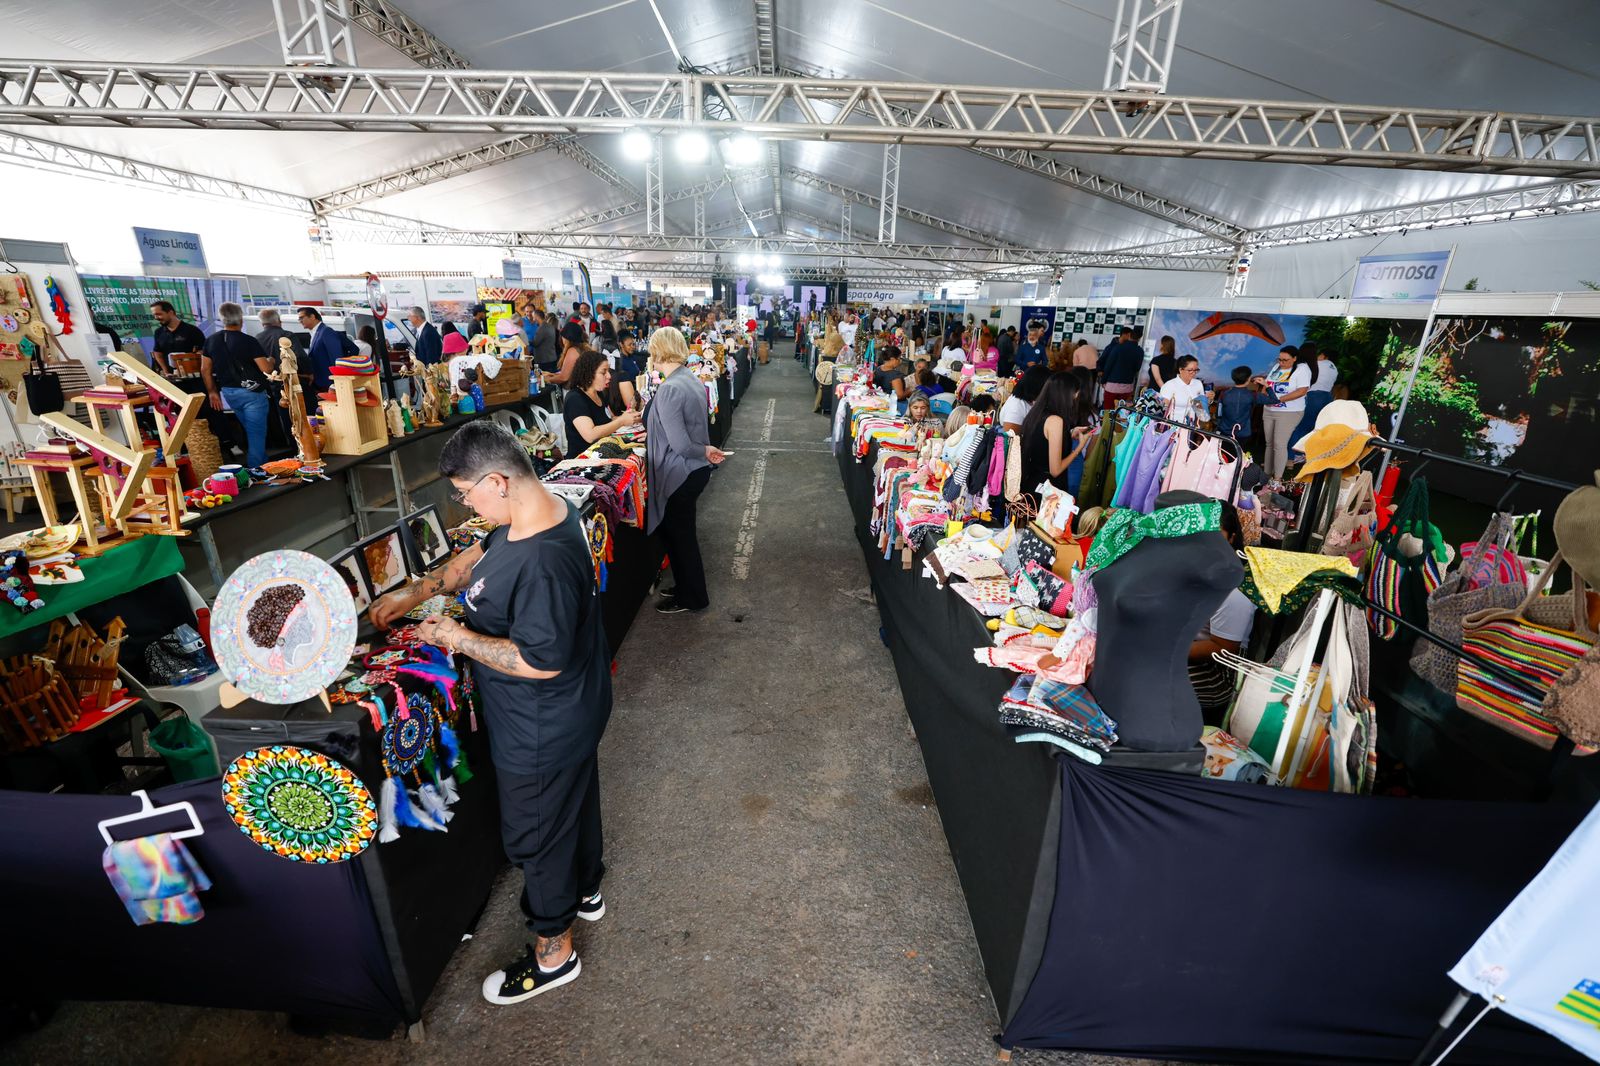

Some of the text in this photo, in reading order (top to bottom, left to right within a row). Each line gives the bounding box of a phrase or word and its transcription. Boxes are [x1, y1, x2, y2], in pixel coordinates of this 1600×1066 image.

[143, 233, 198, 250] Águas Lindas
[1361, 264, 1439, 280] Formosa
[84, 287, 106, 295] LIVRE
[106, 287, 128, 295] ENTRE
[847, 291, 894, 301] spaço Agro
